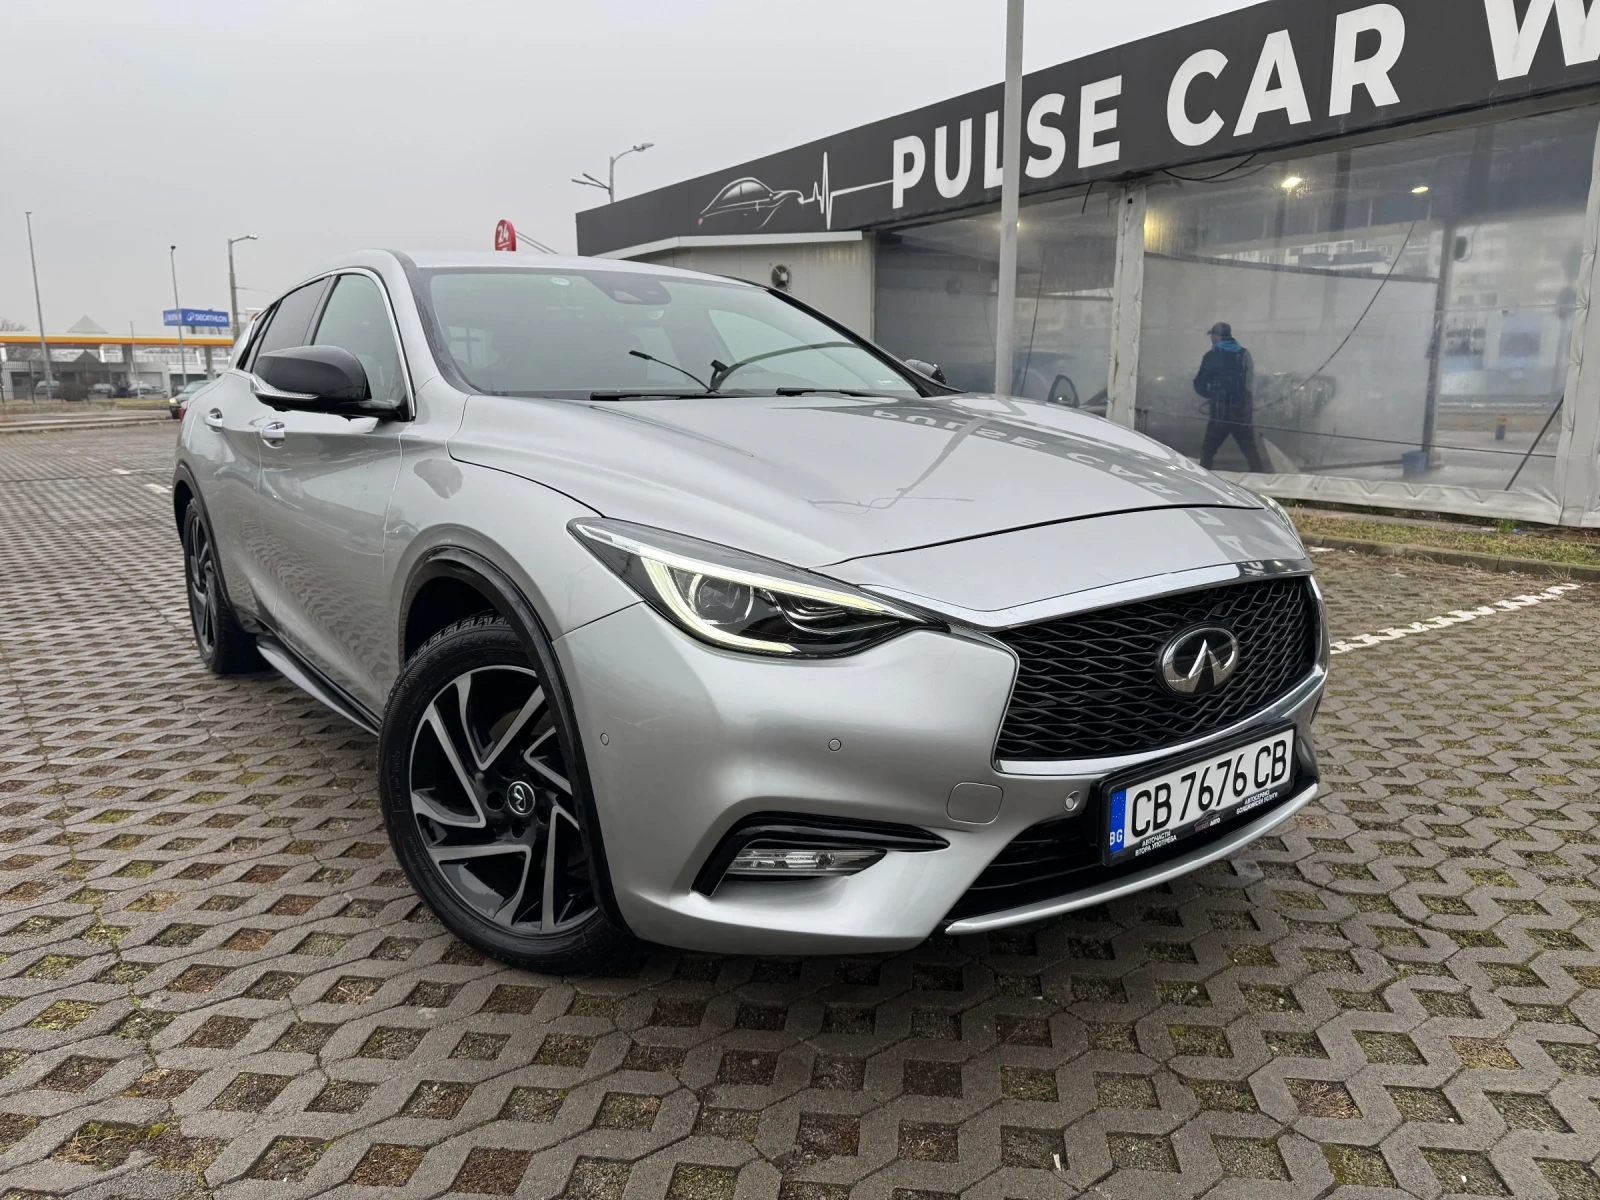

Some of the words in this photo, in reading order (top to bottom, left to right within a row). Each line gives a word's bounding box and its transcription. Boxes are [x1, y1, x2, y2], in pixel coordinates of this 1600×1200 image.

[893, 75, 1122, 209] PULSE
[1166, 3, 1406, 147] CAR
[194, 313, 228, 323] DECATHLON
[1131, 782, 1172, 838] CB
[1179, 753, 1247, 821] 7676
[1254, 739, 1287, 789] CB
[1109, 829, 1123, 845] BG
